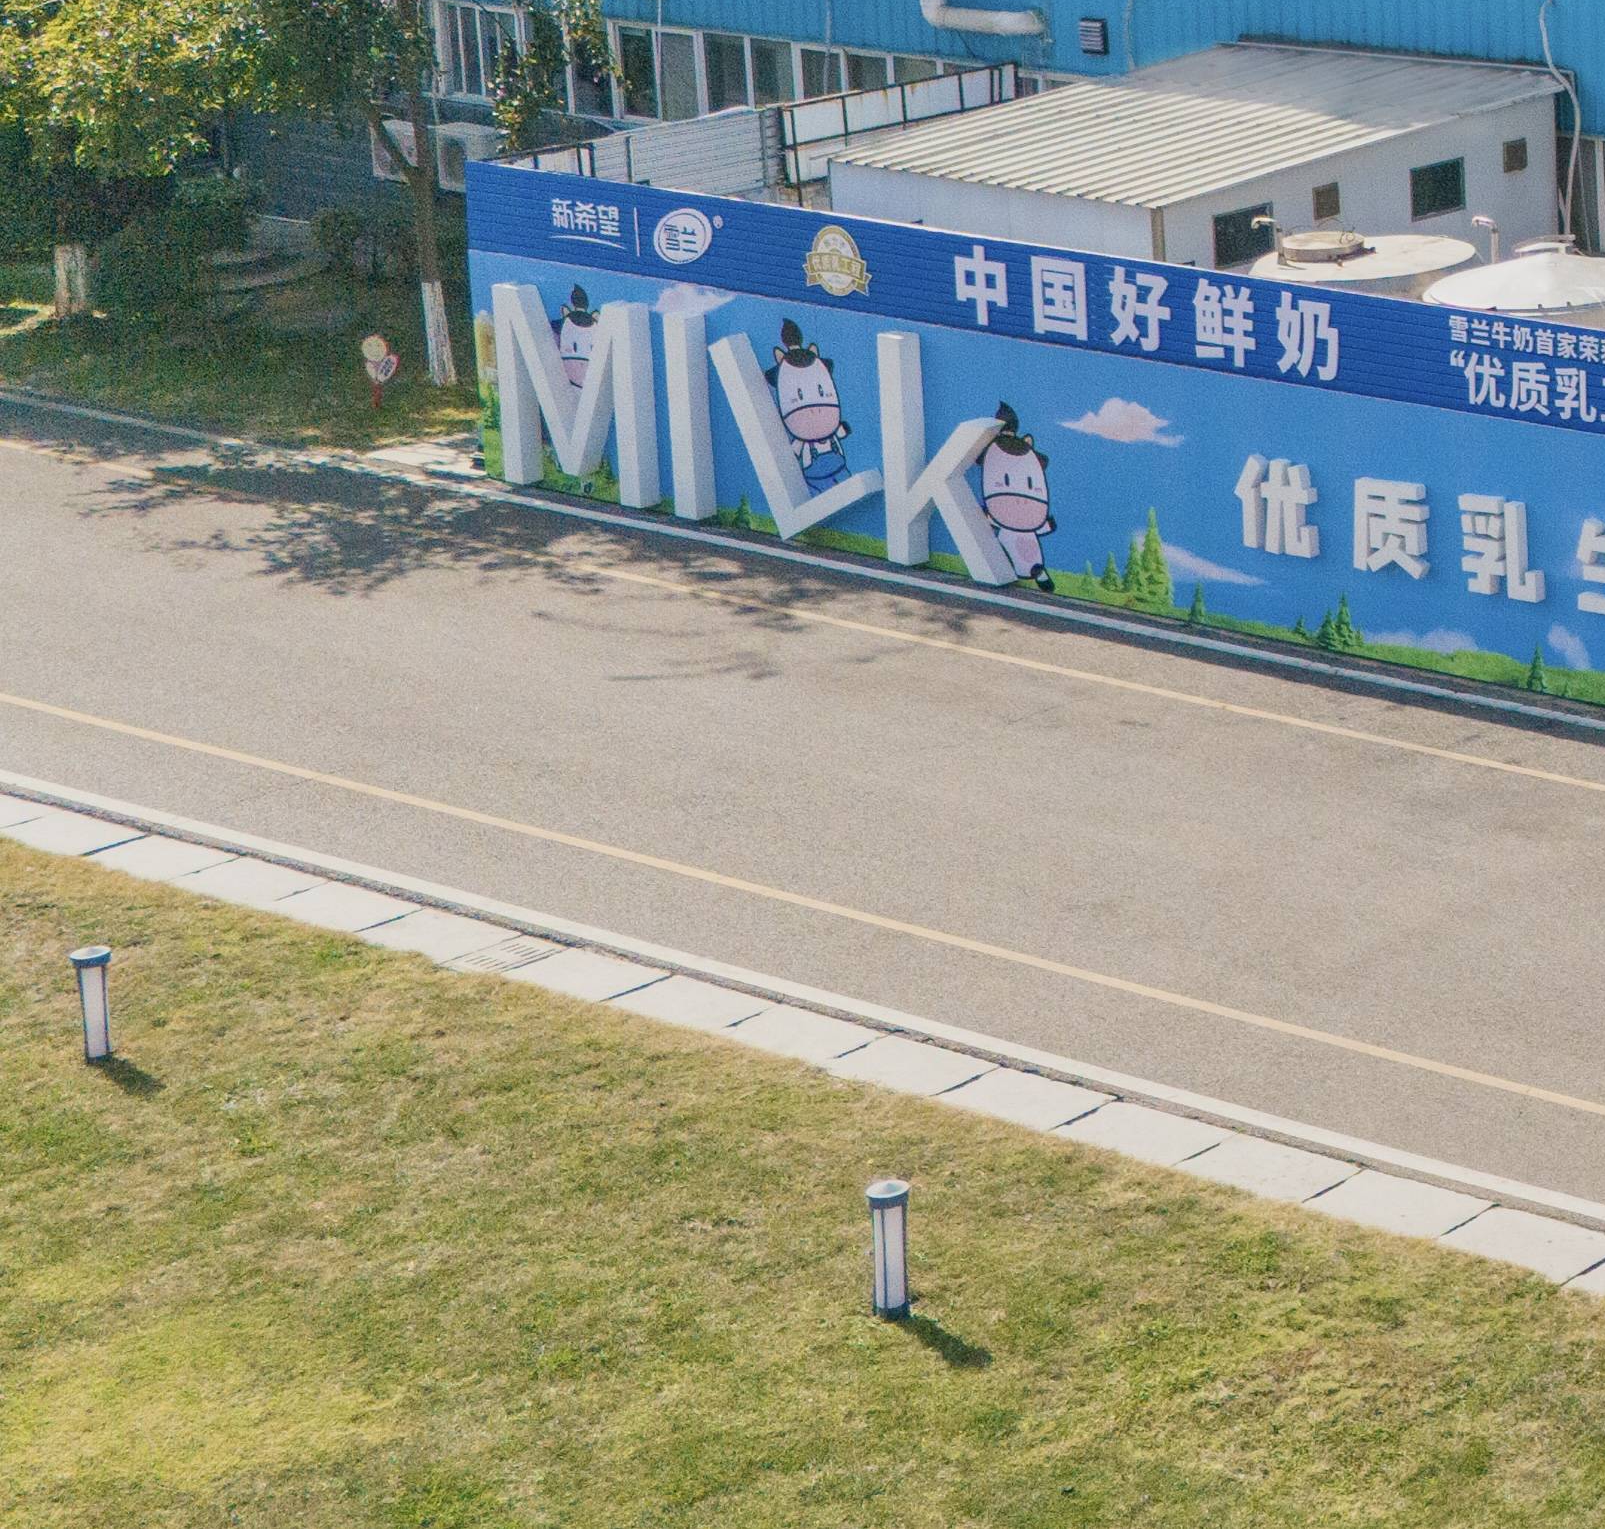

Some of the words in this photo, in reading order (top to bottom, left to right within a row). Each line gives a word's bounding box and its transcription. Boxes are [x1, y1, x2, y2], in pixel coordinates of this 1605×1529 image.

[551, 198, 621, 237] 新希望
[953, 244, 1340, 381] 中国好鲜奶
